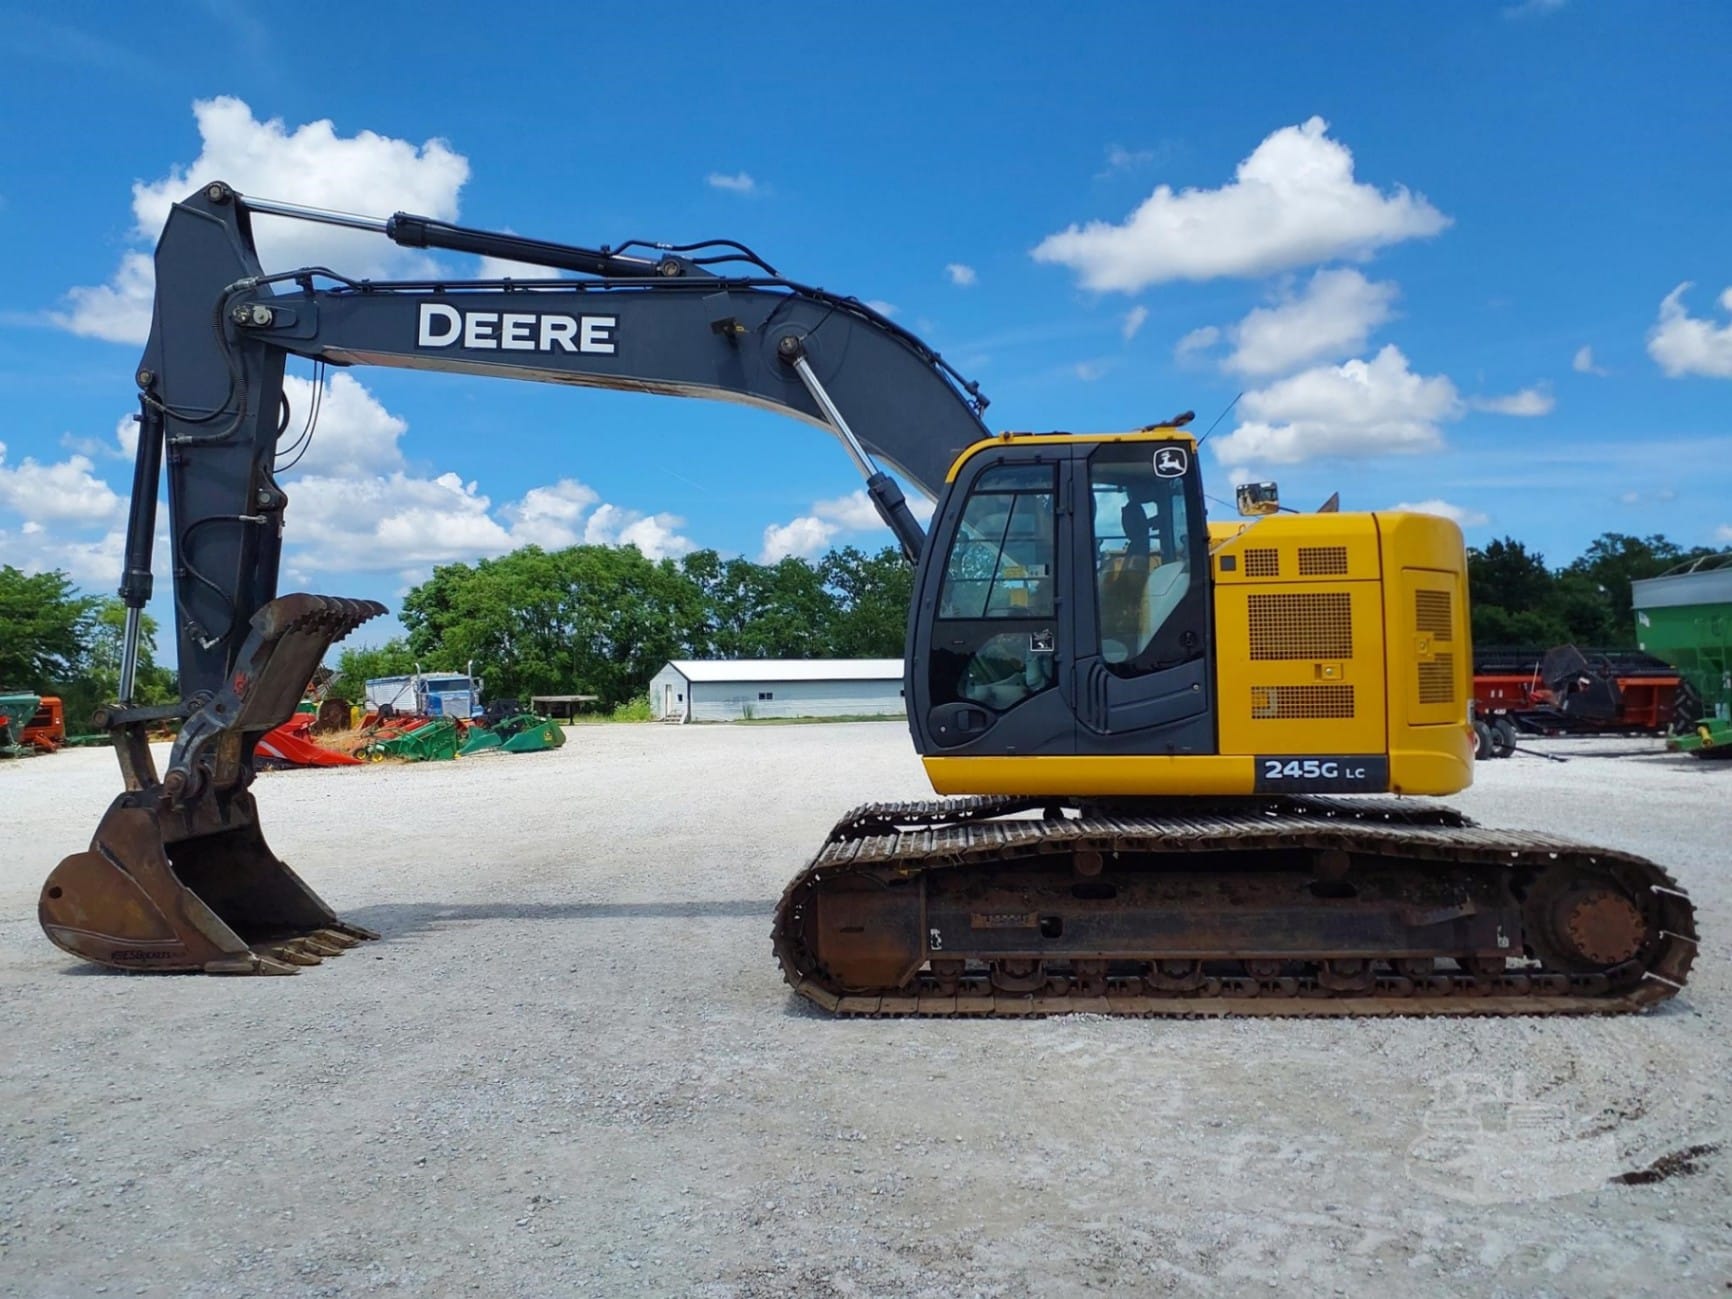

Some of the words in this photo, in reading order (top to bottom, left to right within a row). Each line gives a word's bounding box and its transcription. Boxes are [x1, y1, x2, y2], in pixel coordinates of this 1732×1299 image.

[418, 303, 616, 353] DEERE
[1265, 760, 1338, 778] 245G
[1345, 768, 1366, 778] LC
